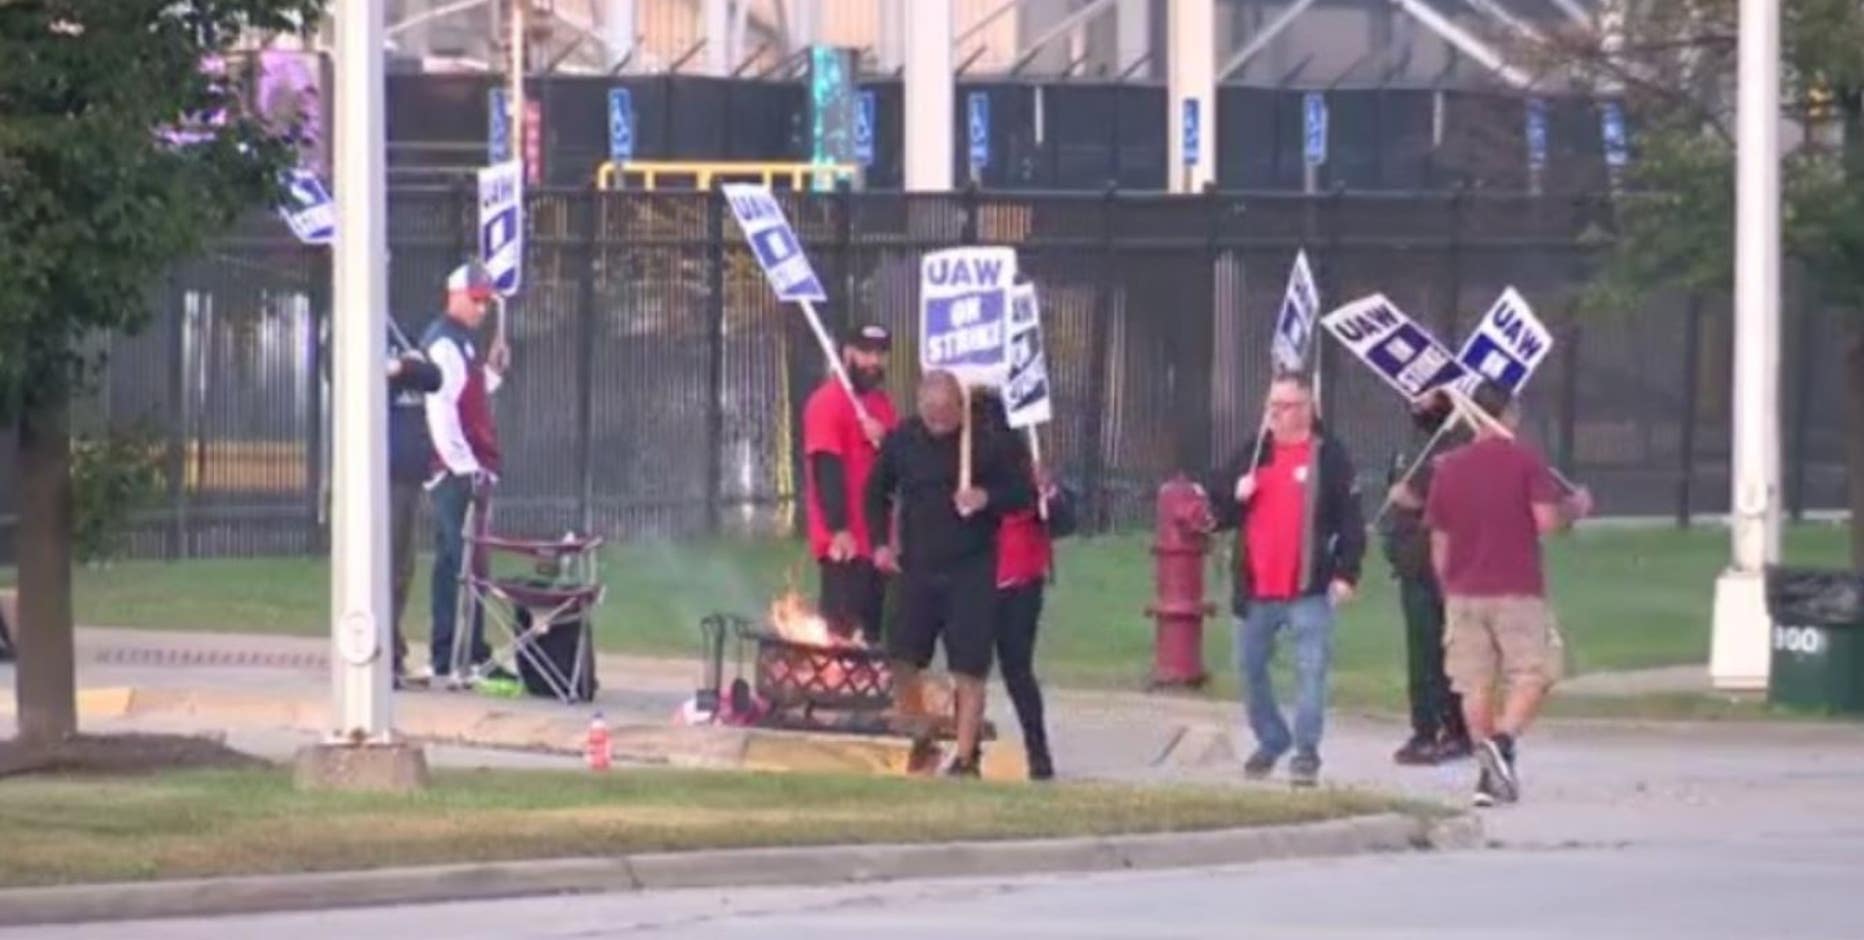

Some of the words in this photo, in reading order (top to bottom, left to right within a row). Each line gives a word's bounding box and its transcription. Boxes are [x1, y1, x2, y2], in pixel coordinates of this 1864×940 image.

[927, 257, 1003, 286] UAW
[928, 321, 1004, 363] STRIKE
[1333, 303, 1399, 342] UAW
[1493, 301, 1543, 361] UAW
